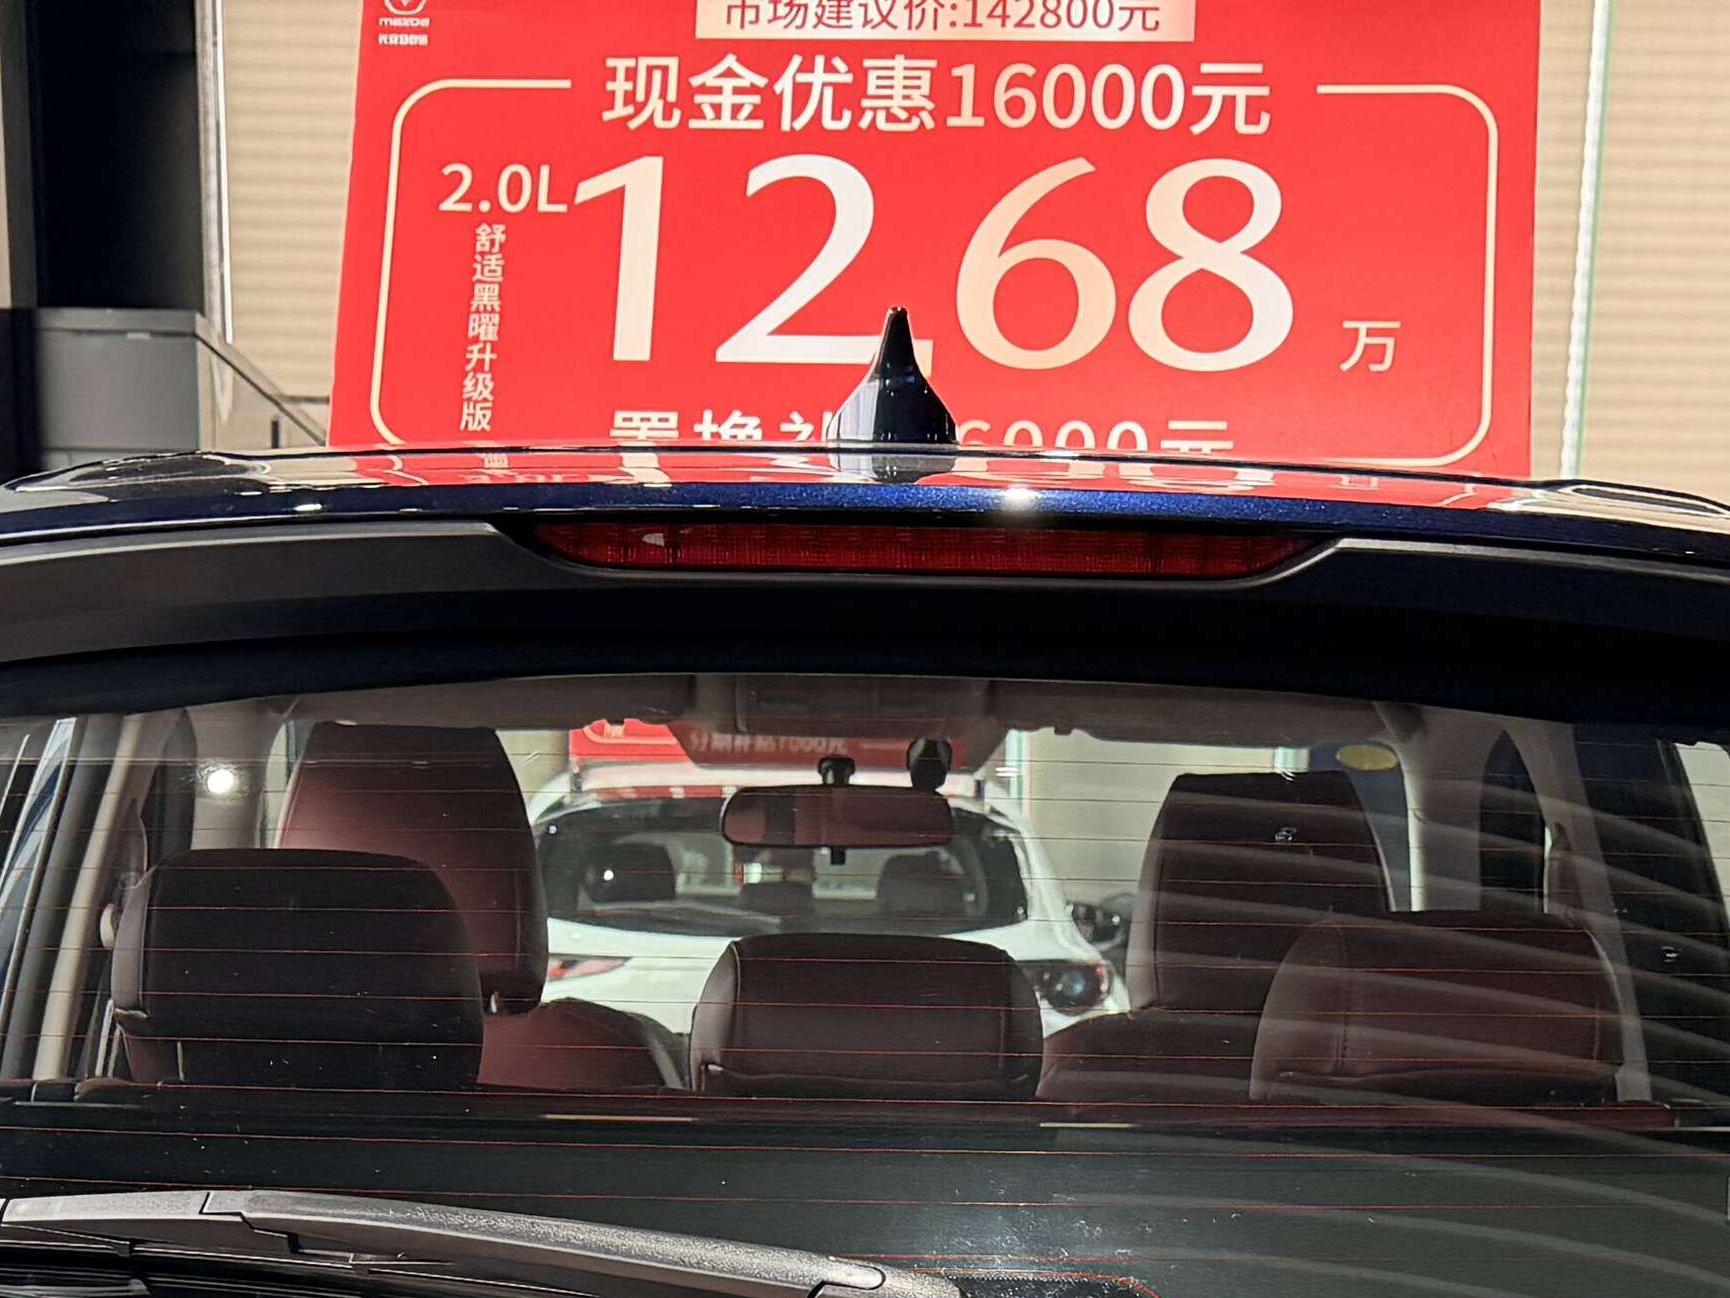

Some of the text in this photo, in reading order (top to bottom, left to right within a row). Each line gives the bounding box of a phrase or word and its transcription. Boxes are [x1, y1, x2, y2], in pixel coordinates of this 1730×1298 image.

[602, 53, 1271, 135] 现金优惠16000元
[439, 162, 569, 213] 2.0L
[459, 223, 507, 432] 舒适黑曜升级版
[1340, 319, 1401, 373] 万
